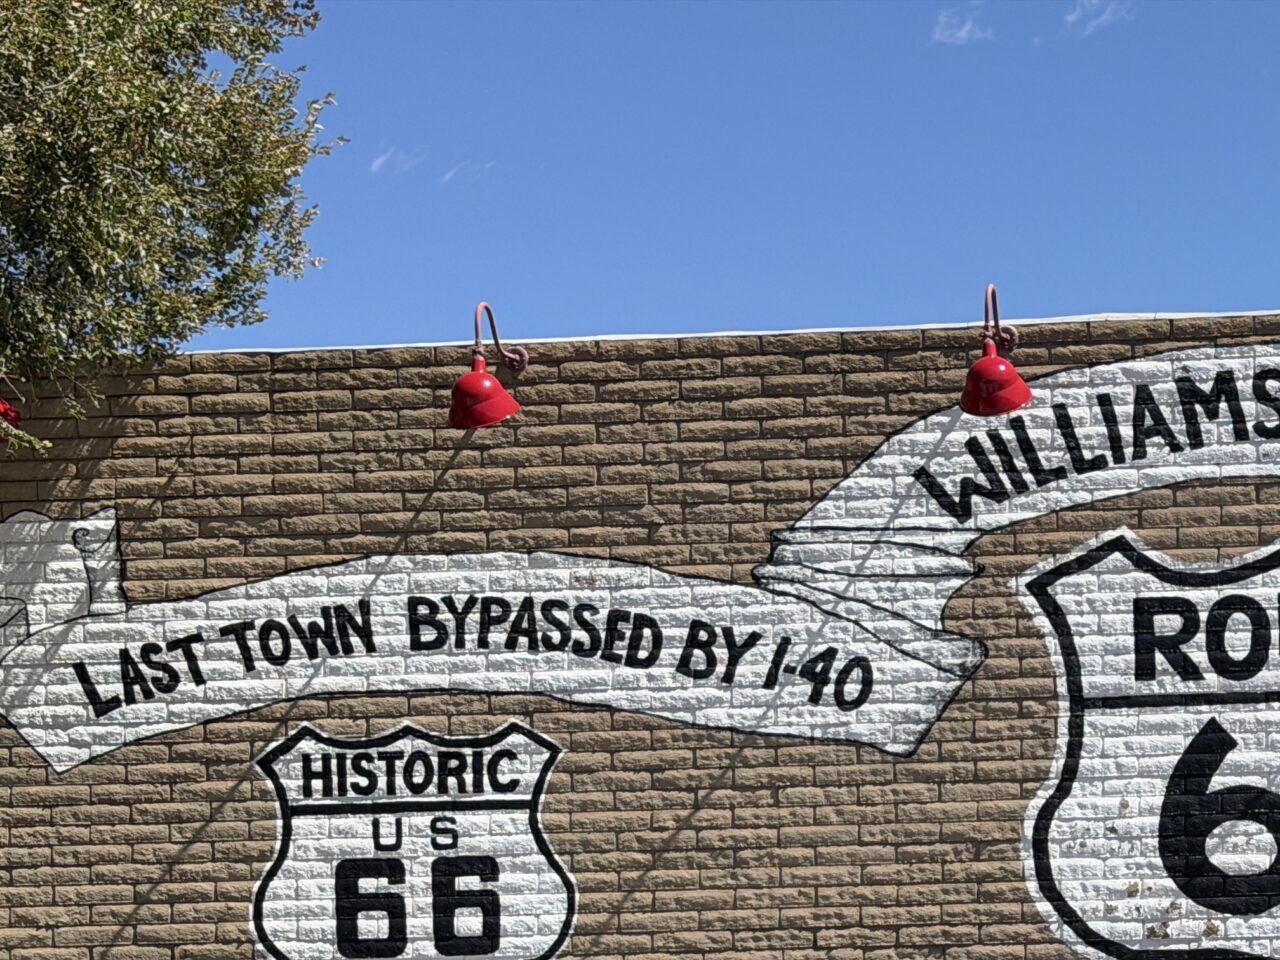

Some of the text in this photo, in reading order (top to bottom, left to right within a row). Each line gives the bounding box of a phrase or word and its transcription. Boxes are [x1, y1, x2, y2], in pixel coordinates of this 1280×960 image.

[72, 594, 874, 718] LAST TOWN BYPASSED BY I-40
[301, 749, 519, 798] HISTORIC
[334, 856, 502, 959] 66
